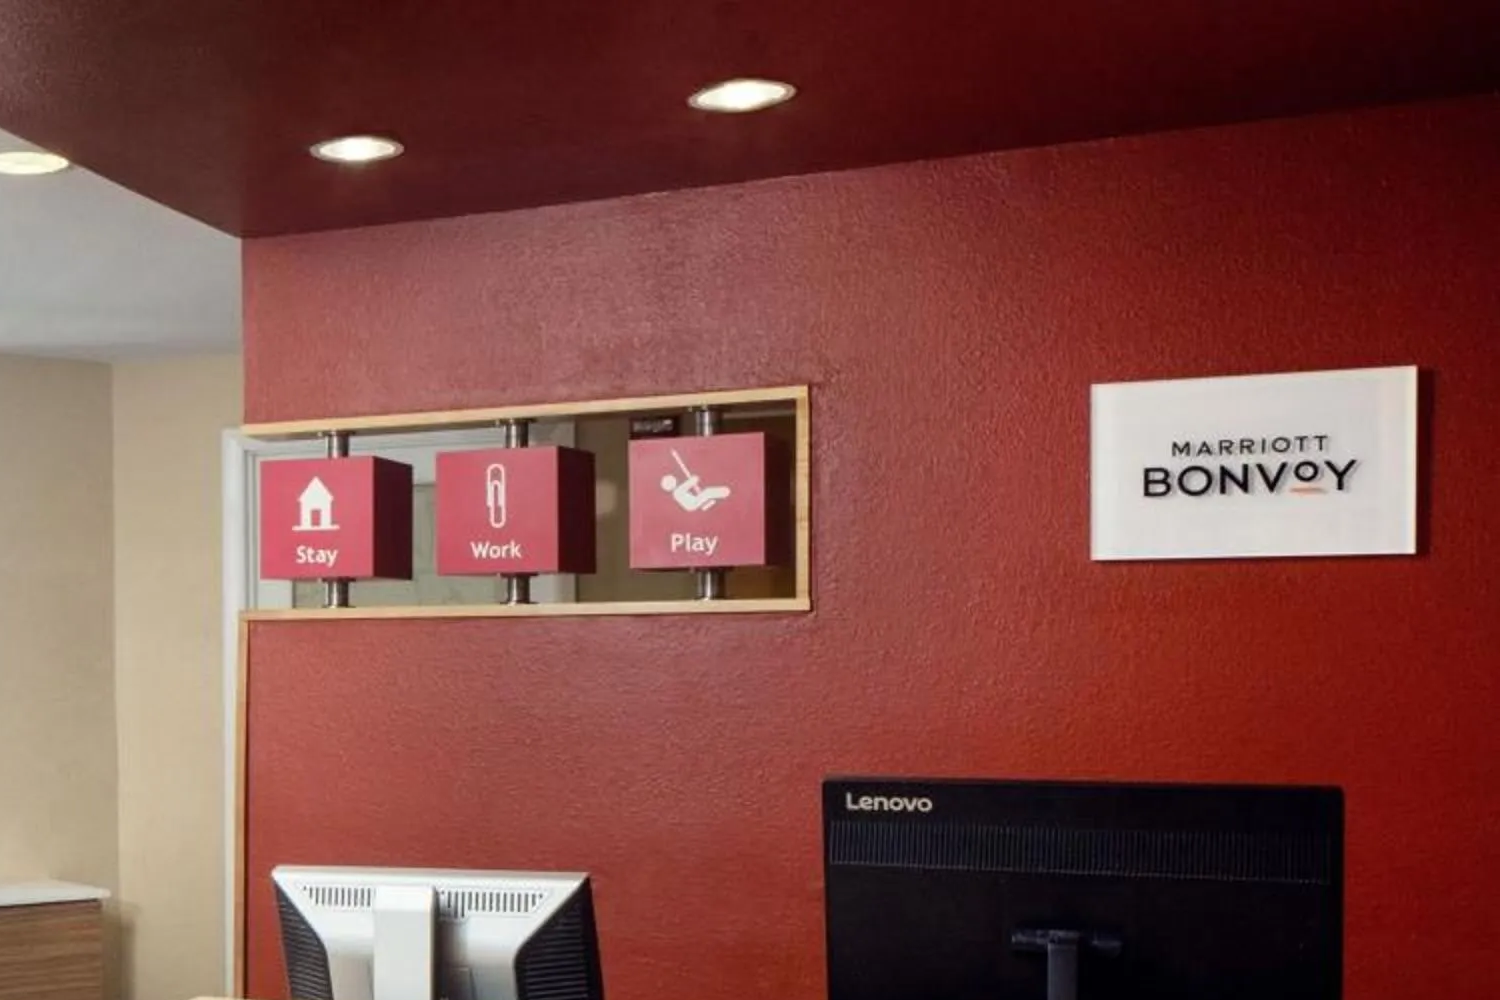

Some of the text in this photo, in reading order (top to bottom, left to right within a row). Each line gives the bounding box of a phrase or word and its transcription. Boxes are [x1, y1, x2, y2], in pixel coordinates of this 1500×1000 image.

[1171, 435, 1329, 457] MARRIOTT
[1143, 459, 1358, 498] BONVOY
[470, 540, 522, 560] Work
[671, 532, 718, 556] Play
[296, 545, 338, 567] Stay
[845, 792, 933, 813] Lenovo
